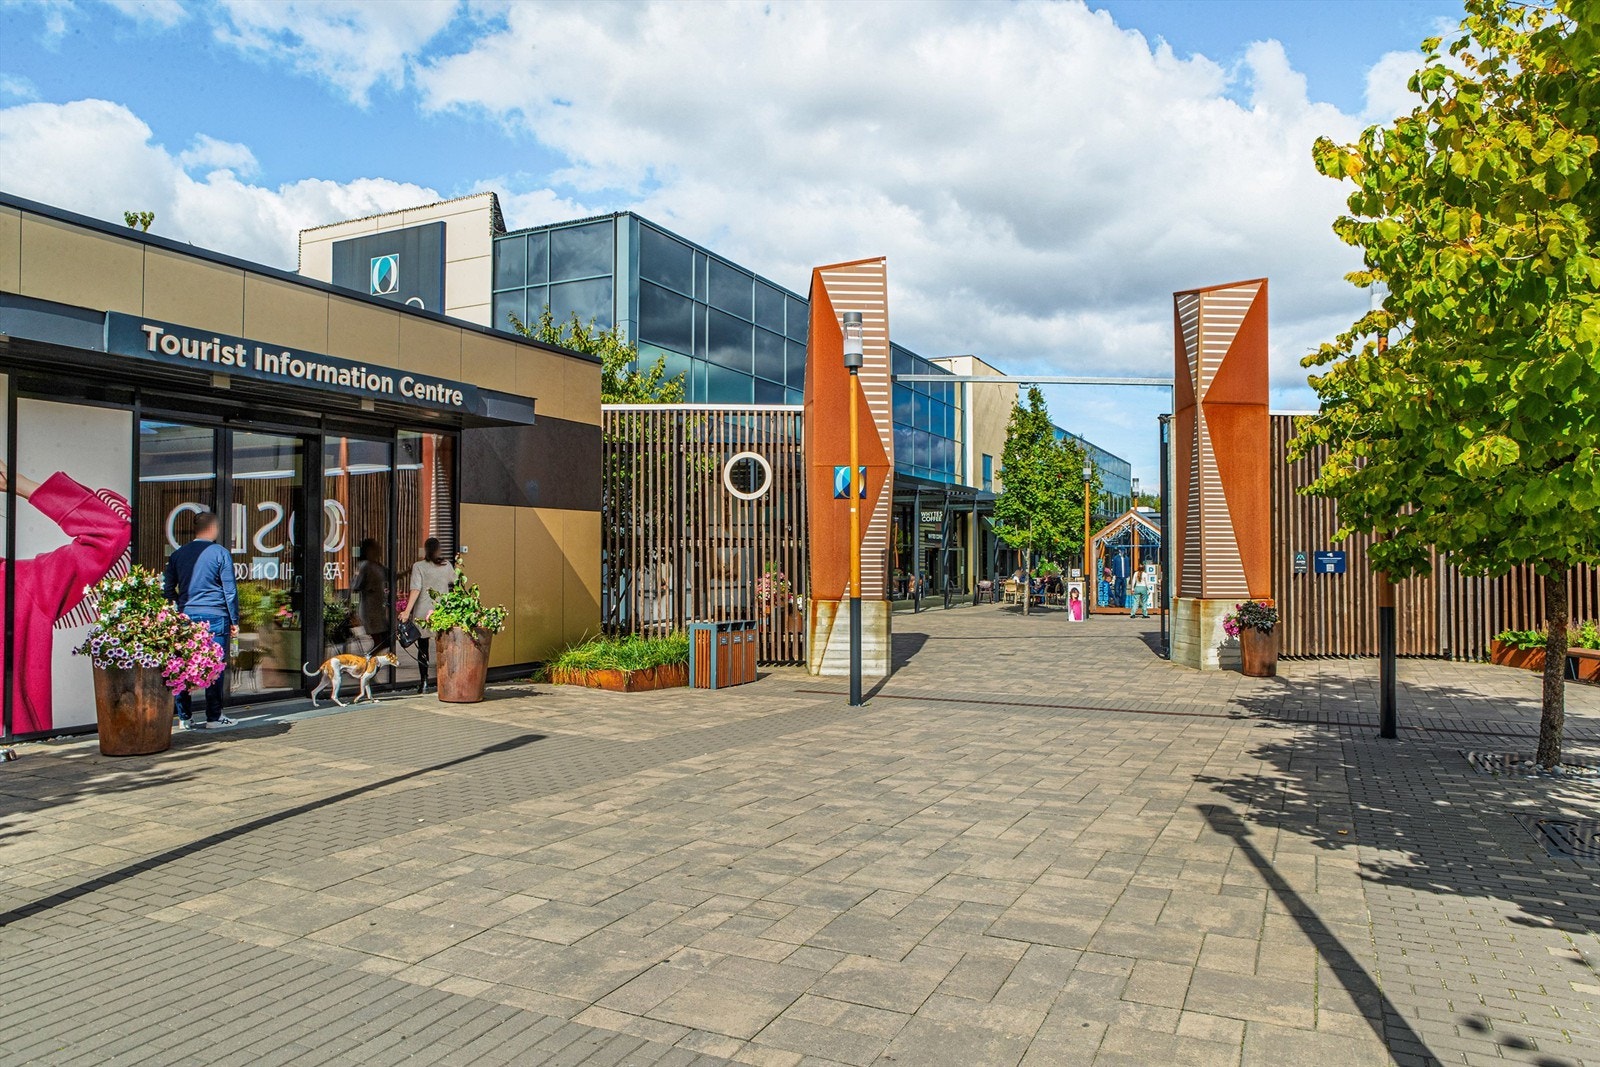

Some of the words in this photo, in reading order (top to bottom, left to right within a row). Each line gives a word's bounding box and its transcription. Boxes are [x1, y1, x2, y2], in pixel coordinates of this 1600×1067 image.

[142, 324, 247, 368] Tourist
[254, 347, 393, 393] Information
[399, 376, 463, 407] Centre
